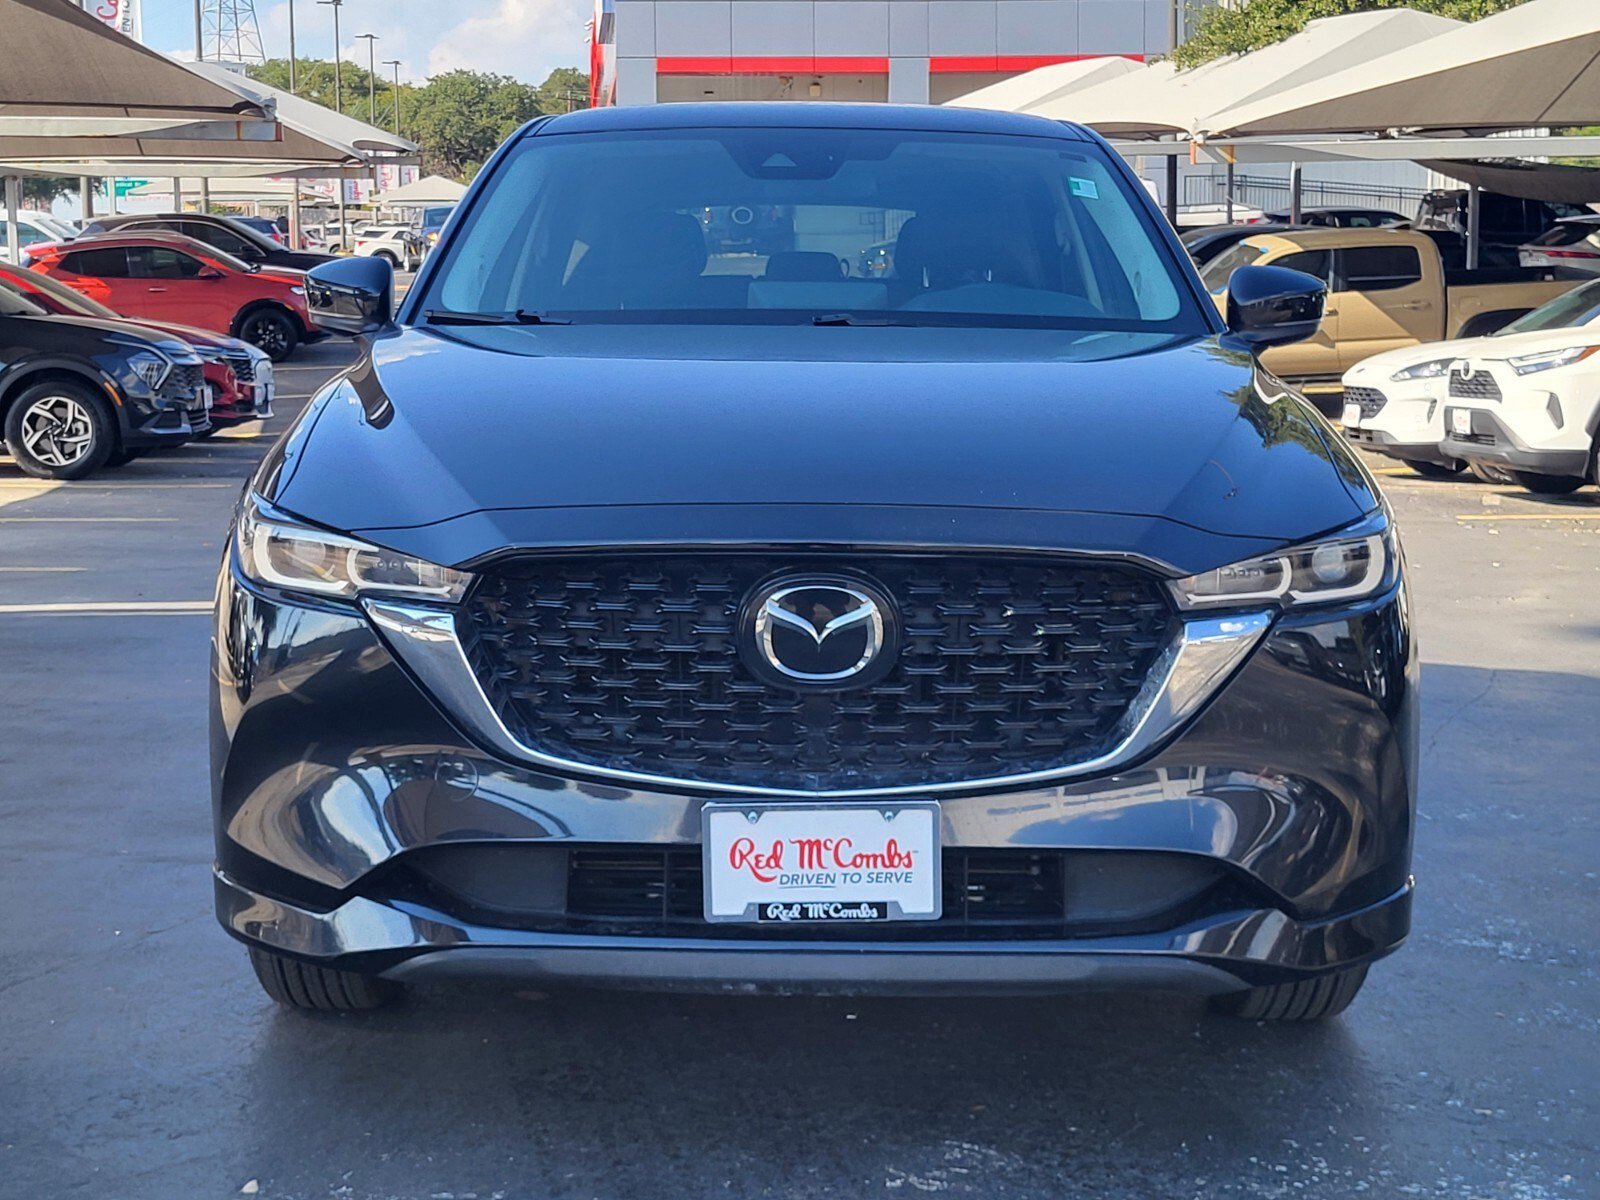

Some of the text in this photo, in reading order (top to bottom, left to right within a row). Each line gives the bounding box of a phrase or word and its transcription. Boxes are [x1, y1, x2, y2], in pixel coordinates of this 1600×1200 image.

[730, 838, 912, 882] Red McCombs
[779, 871, 913, 885] DRIVEN TO SERVE
[767, 903, 878, 920] Red McCombs
